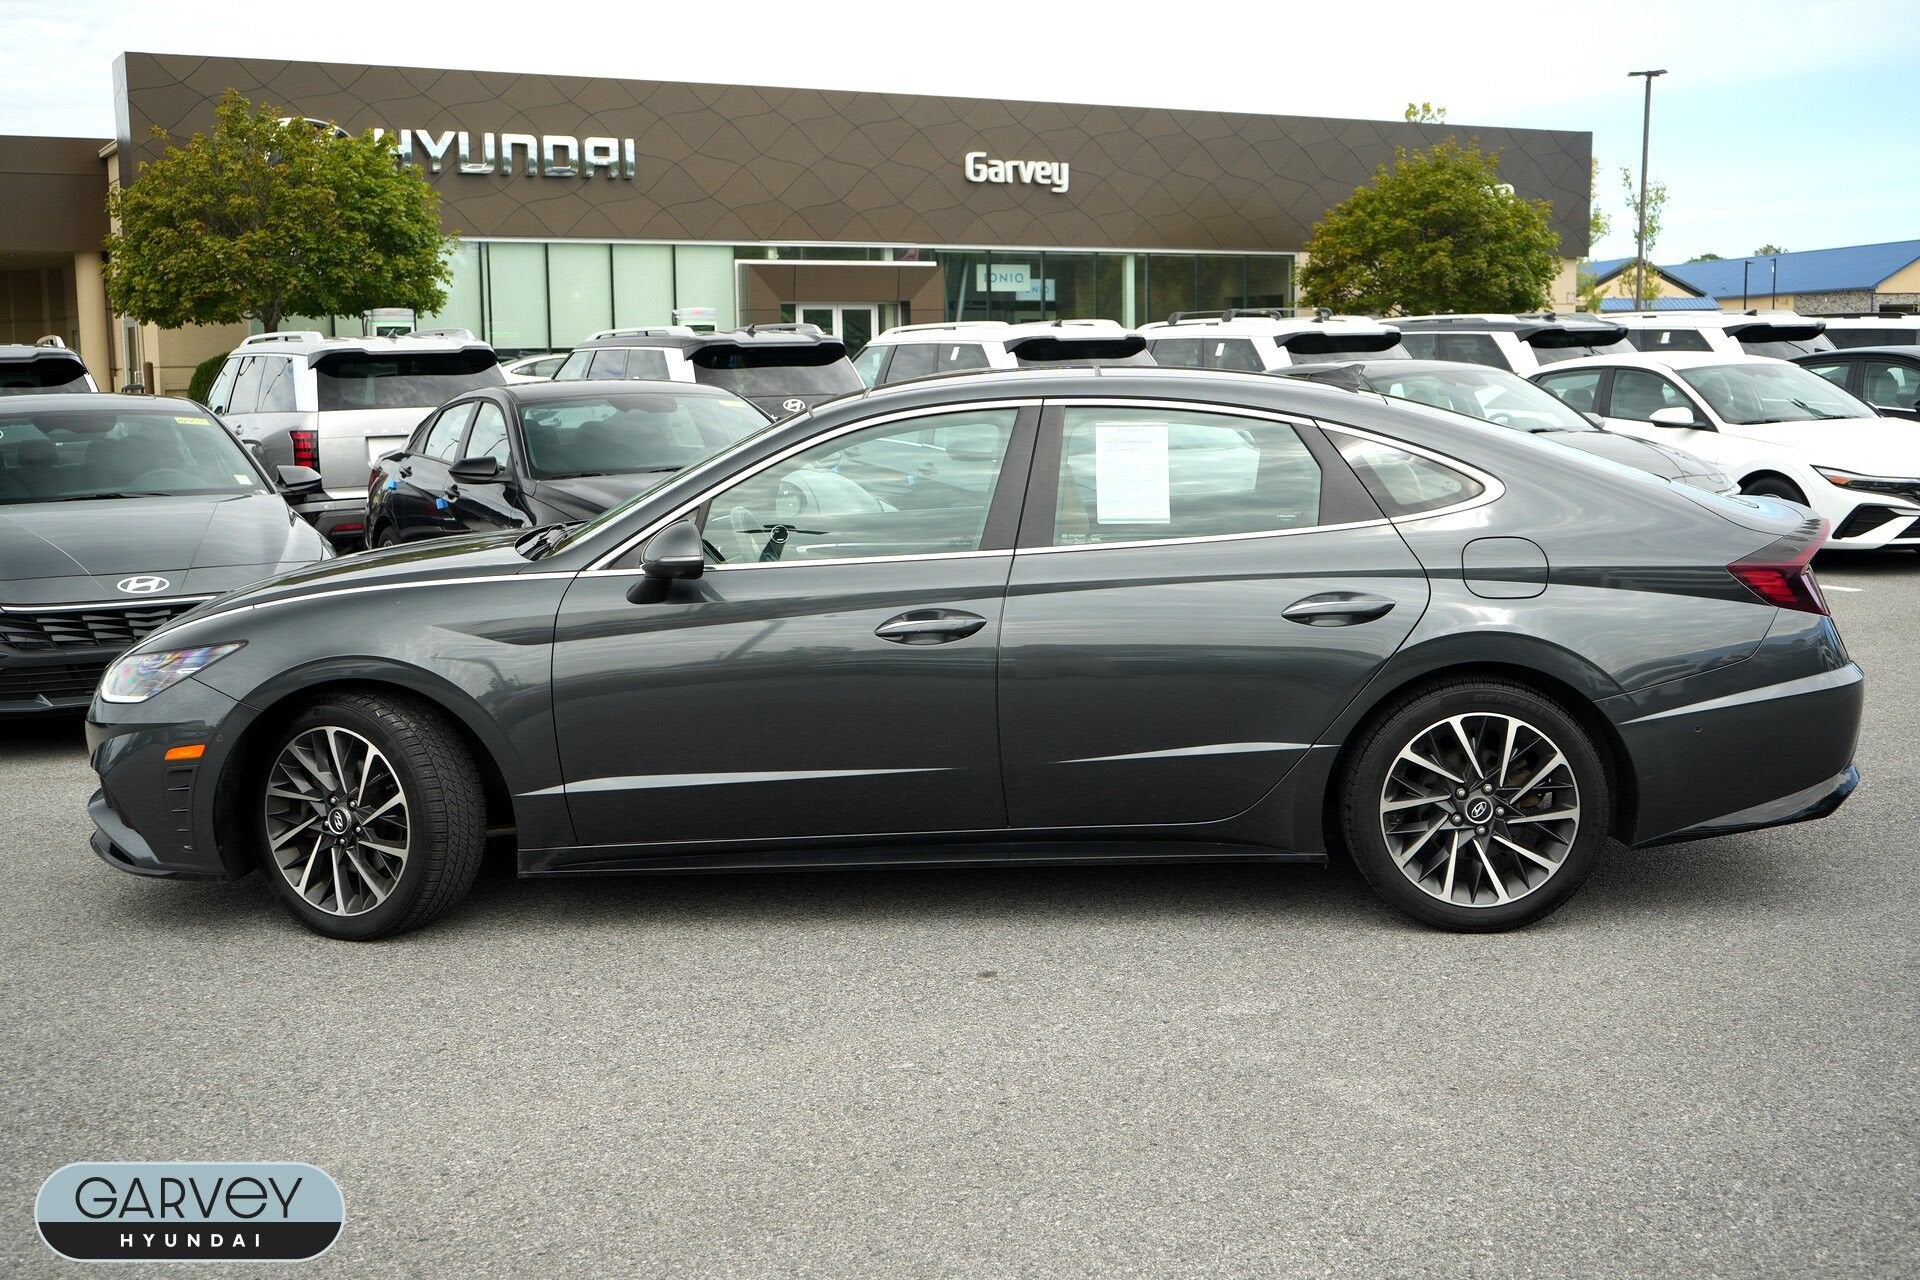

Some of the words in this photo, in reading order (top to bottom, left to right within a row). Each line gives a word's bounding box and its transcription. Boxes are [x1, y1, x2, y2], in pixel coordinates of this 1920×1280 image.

[374, 128, 635, 179] HYUNDAI
[965, 152, 1069, 193] Garvey
[984, 273, 1024, 283] IONIQ
